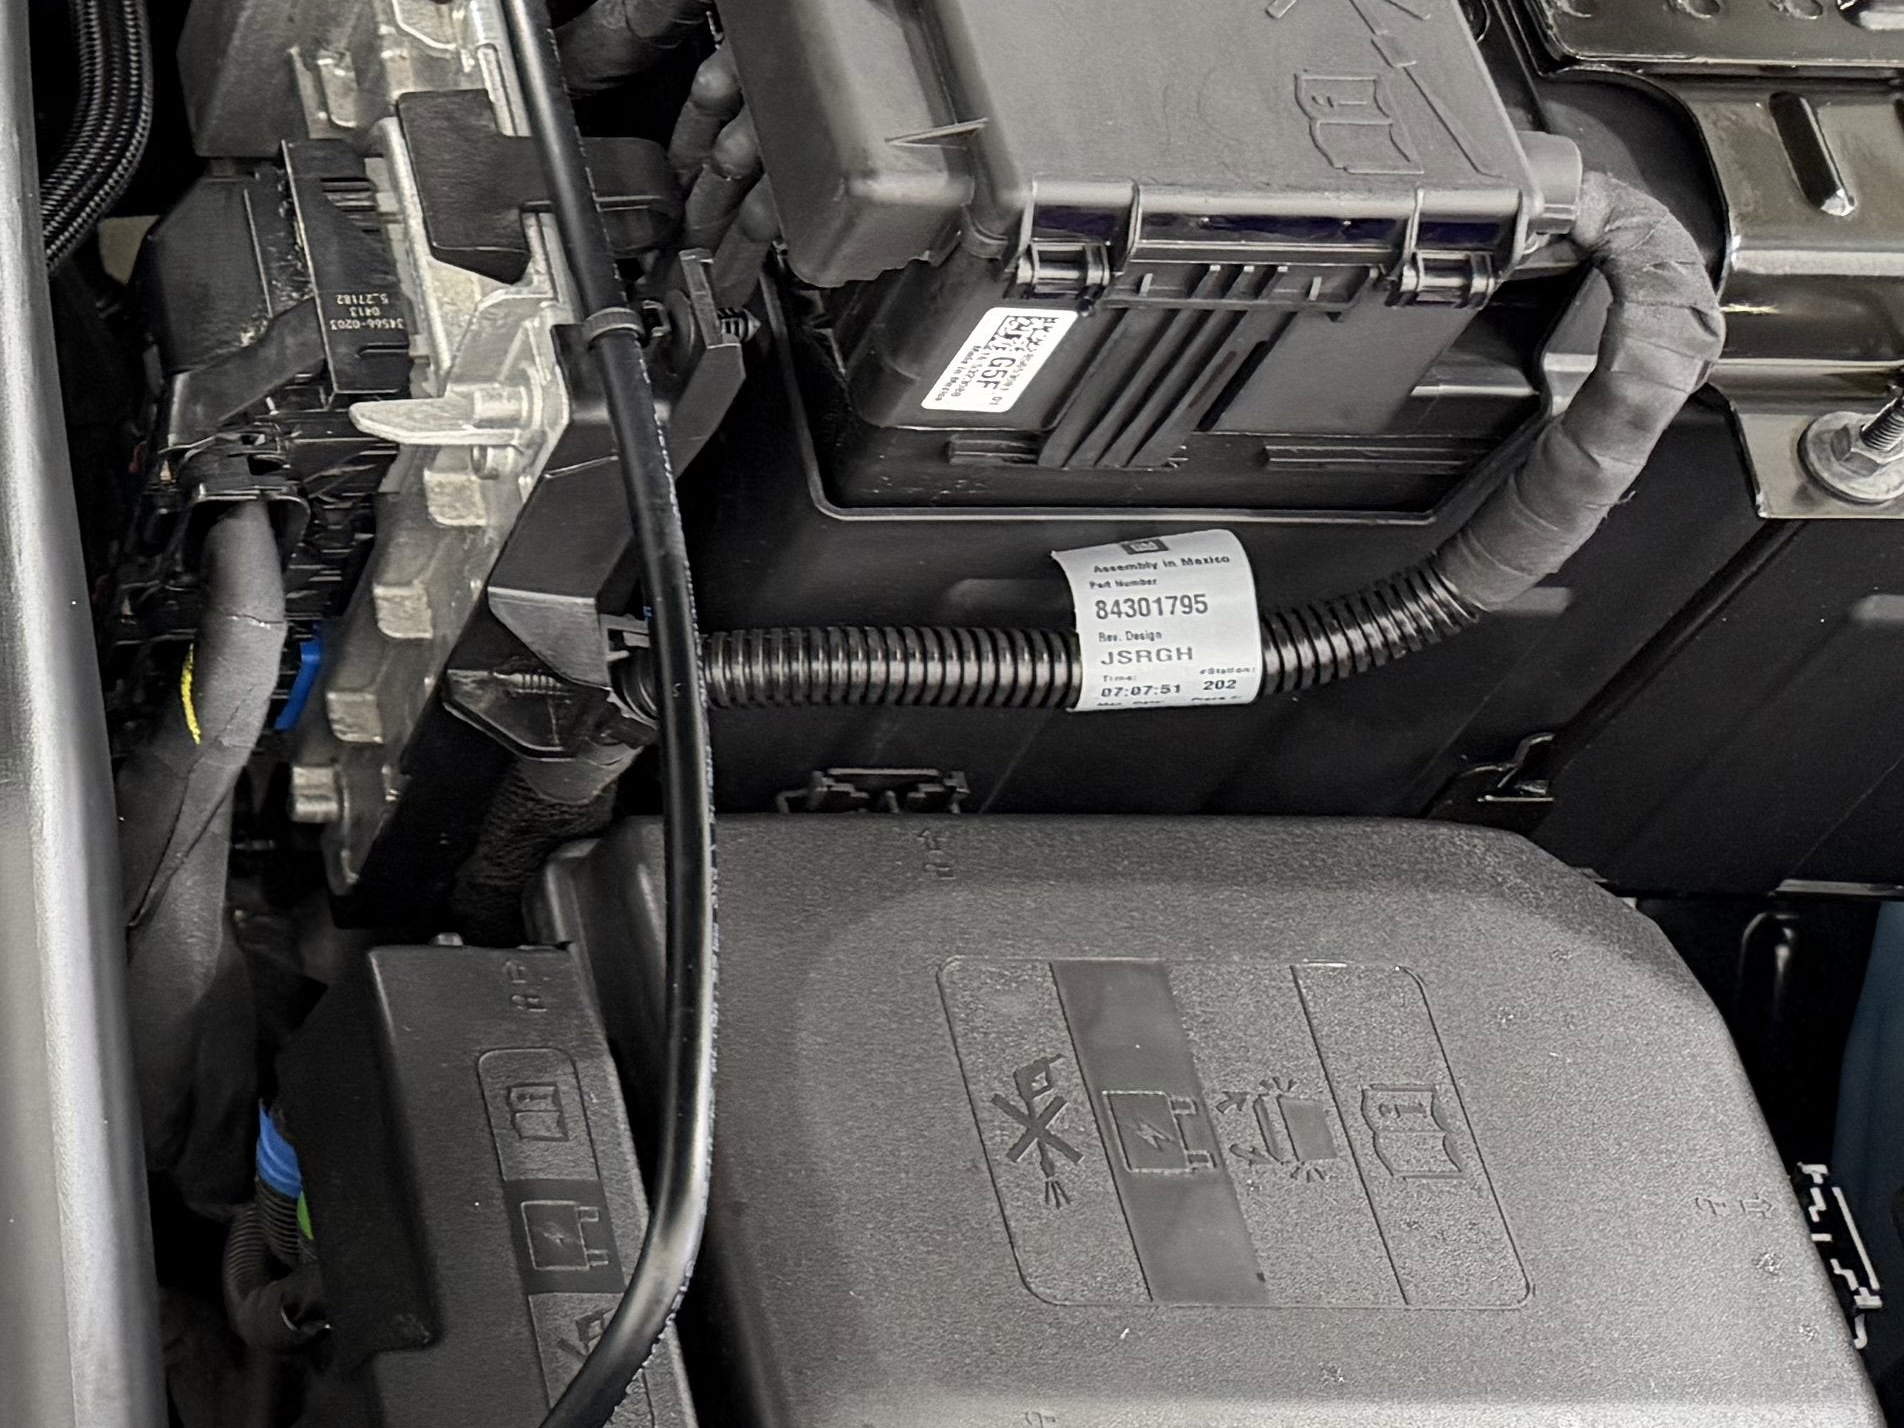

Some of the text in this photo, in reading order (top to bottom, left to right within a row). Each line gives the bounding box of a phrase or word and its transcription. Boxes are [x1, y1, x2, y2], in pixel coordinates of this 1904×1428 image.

[960, 345, 982, 365] Made
[976, 356, 1016, 390] G5F
[1093, 555, 1231, 573] Assembly in Mexico
[1089, 578, 1157, 590] Part Number
[1095, 593, 1208, 621] 84301795
[1125, 630, 1162, 643] Design
[1100, 646, 1193, 666] JSRGH
[1103, 674, 1137, 683] Time:
[1202, 678, 1238, 691] 202
[1100, 683, 1182, 698] 07:07:51
